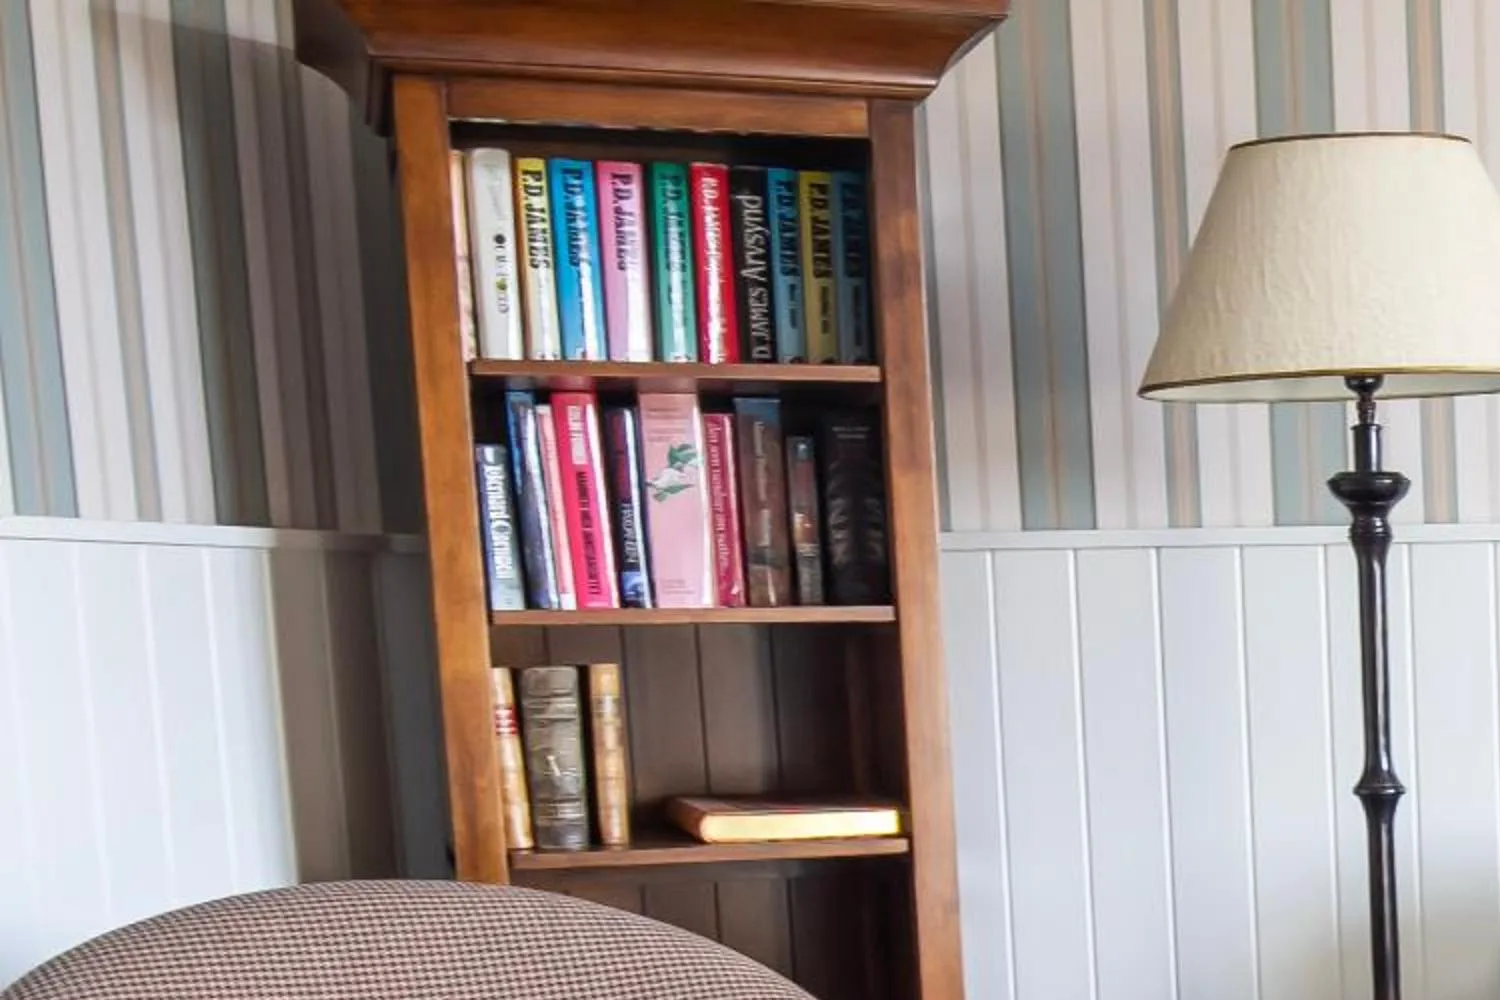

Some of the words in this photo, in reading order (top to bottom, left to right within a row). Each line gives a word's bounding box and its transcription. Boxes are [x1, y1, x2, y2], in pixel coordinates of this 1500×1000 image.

[525, 205, 550, 270] JAMES
[734, 194, 770, 281] Arvsynd
[749, 287, 770, 340] JAMES
